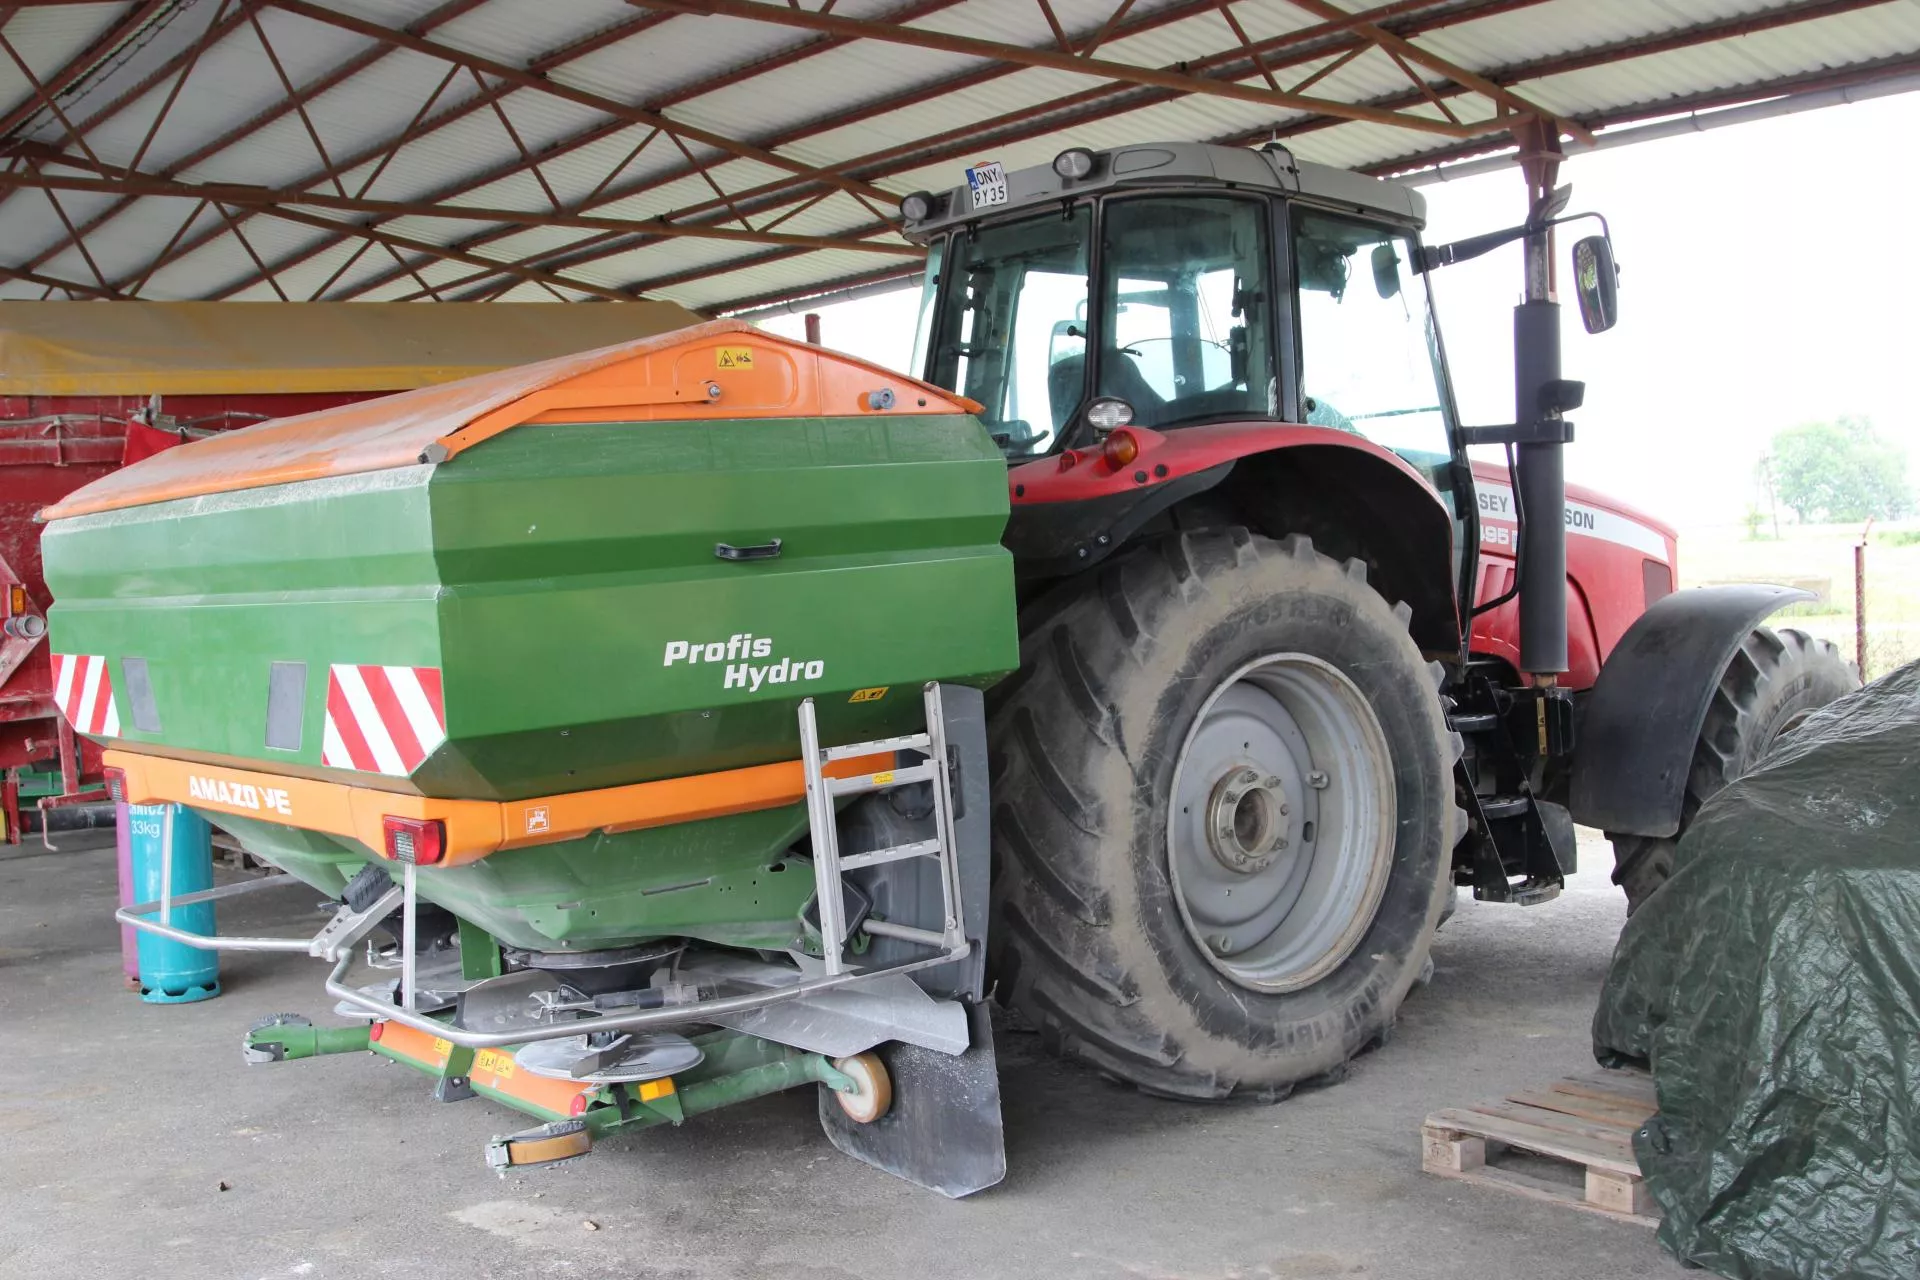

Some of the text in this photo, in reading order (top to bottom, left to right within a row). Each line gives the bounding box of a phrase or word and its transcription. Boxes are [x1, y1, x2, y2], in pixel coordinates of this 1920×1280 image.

[977, 168, 997, 185] ONY
[1478, 492, 1595, 530] SEY SON
[663, 633, 772, 667] Profis
[723, 657, 825, 693] Hydro
[132, 820, 161, 838] 33kg
